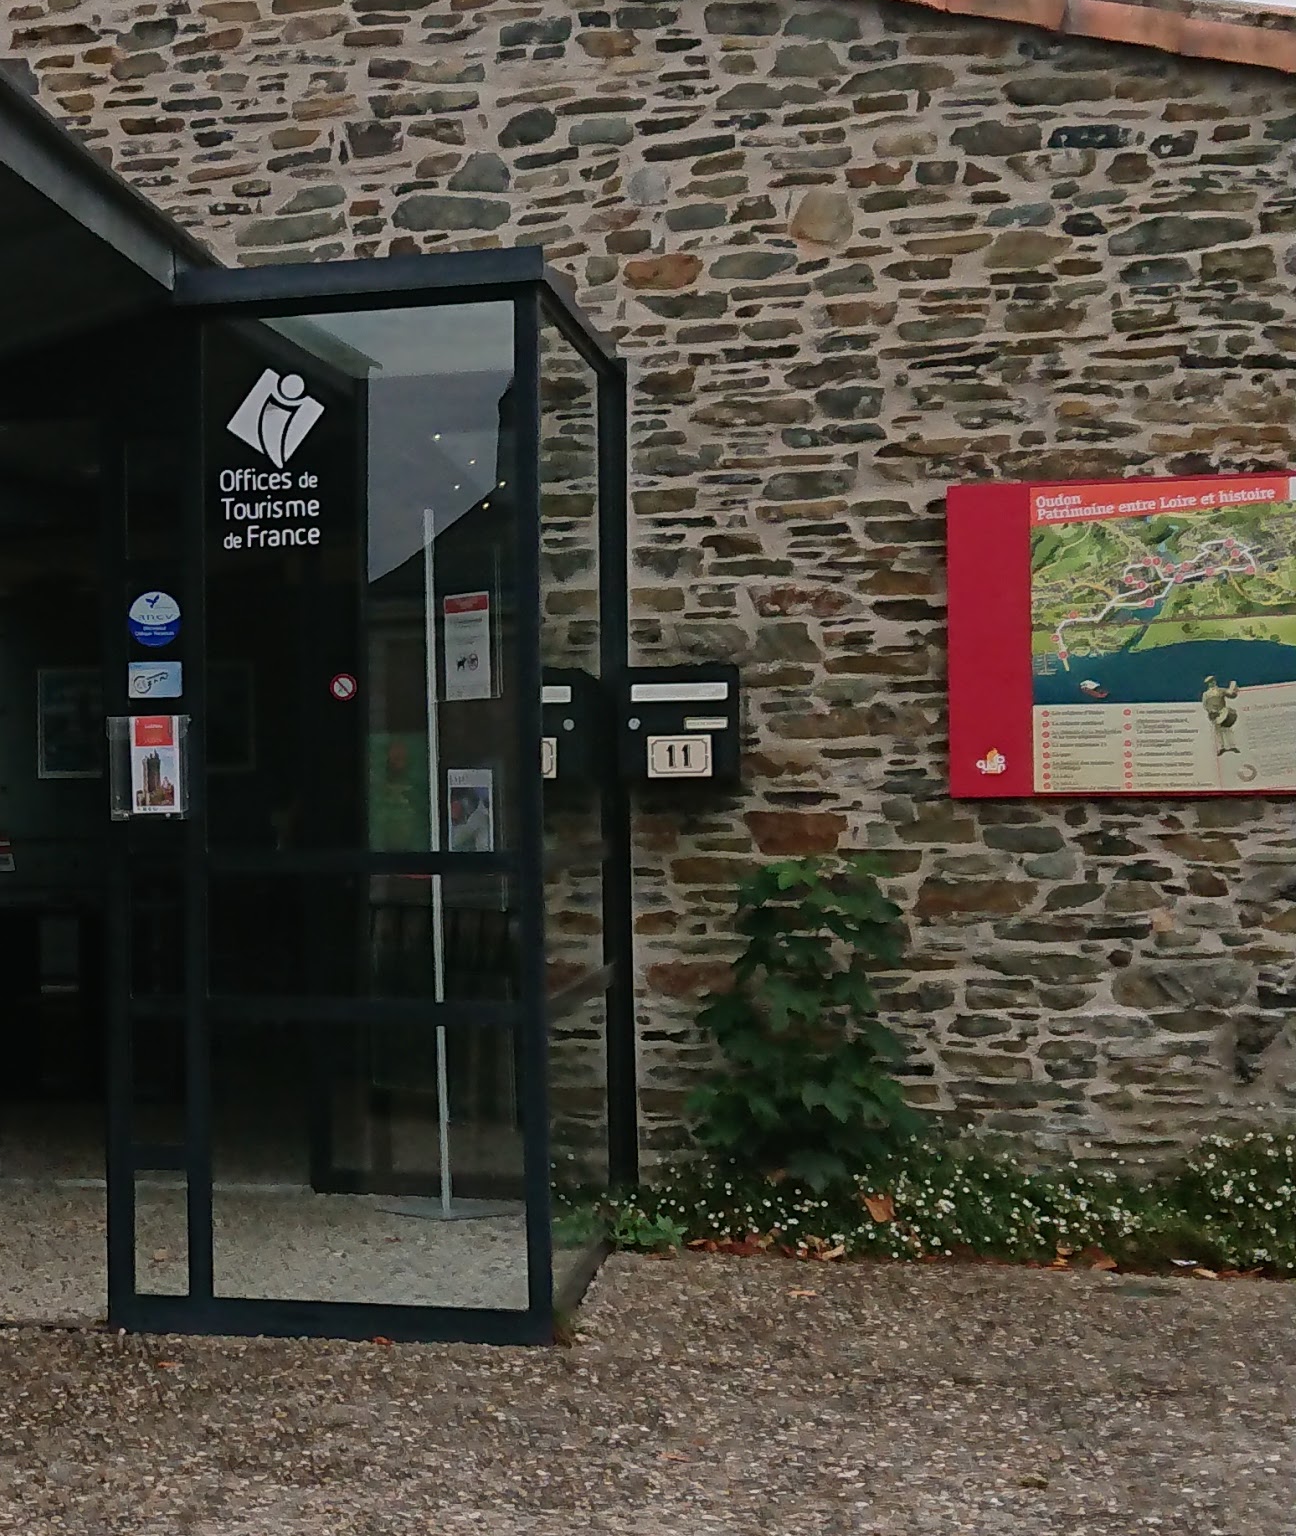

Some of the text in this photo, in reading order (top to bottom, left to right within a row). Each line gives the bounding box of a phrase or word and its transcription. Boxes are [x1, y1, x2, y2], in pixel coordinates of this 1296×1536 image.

[219, 468, 318, 492] Offices de
[220, 494, 320, 520] Tourisme
[1035, 493, 1082, 508] Oudon
[1036, 488, 1276, 520] Patrimoine entre Loire et histoire
[223, 525, 320, 549] de France
[665, 744, 692, 768] 11
